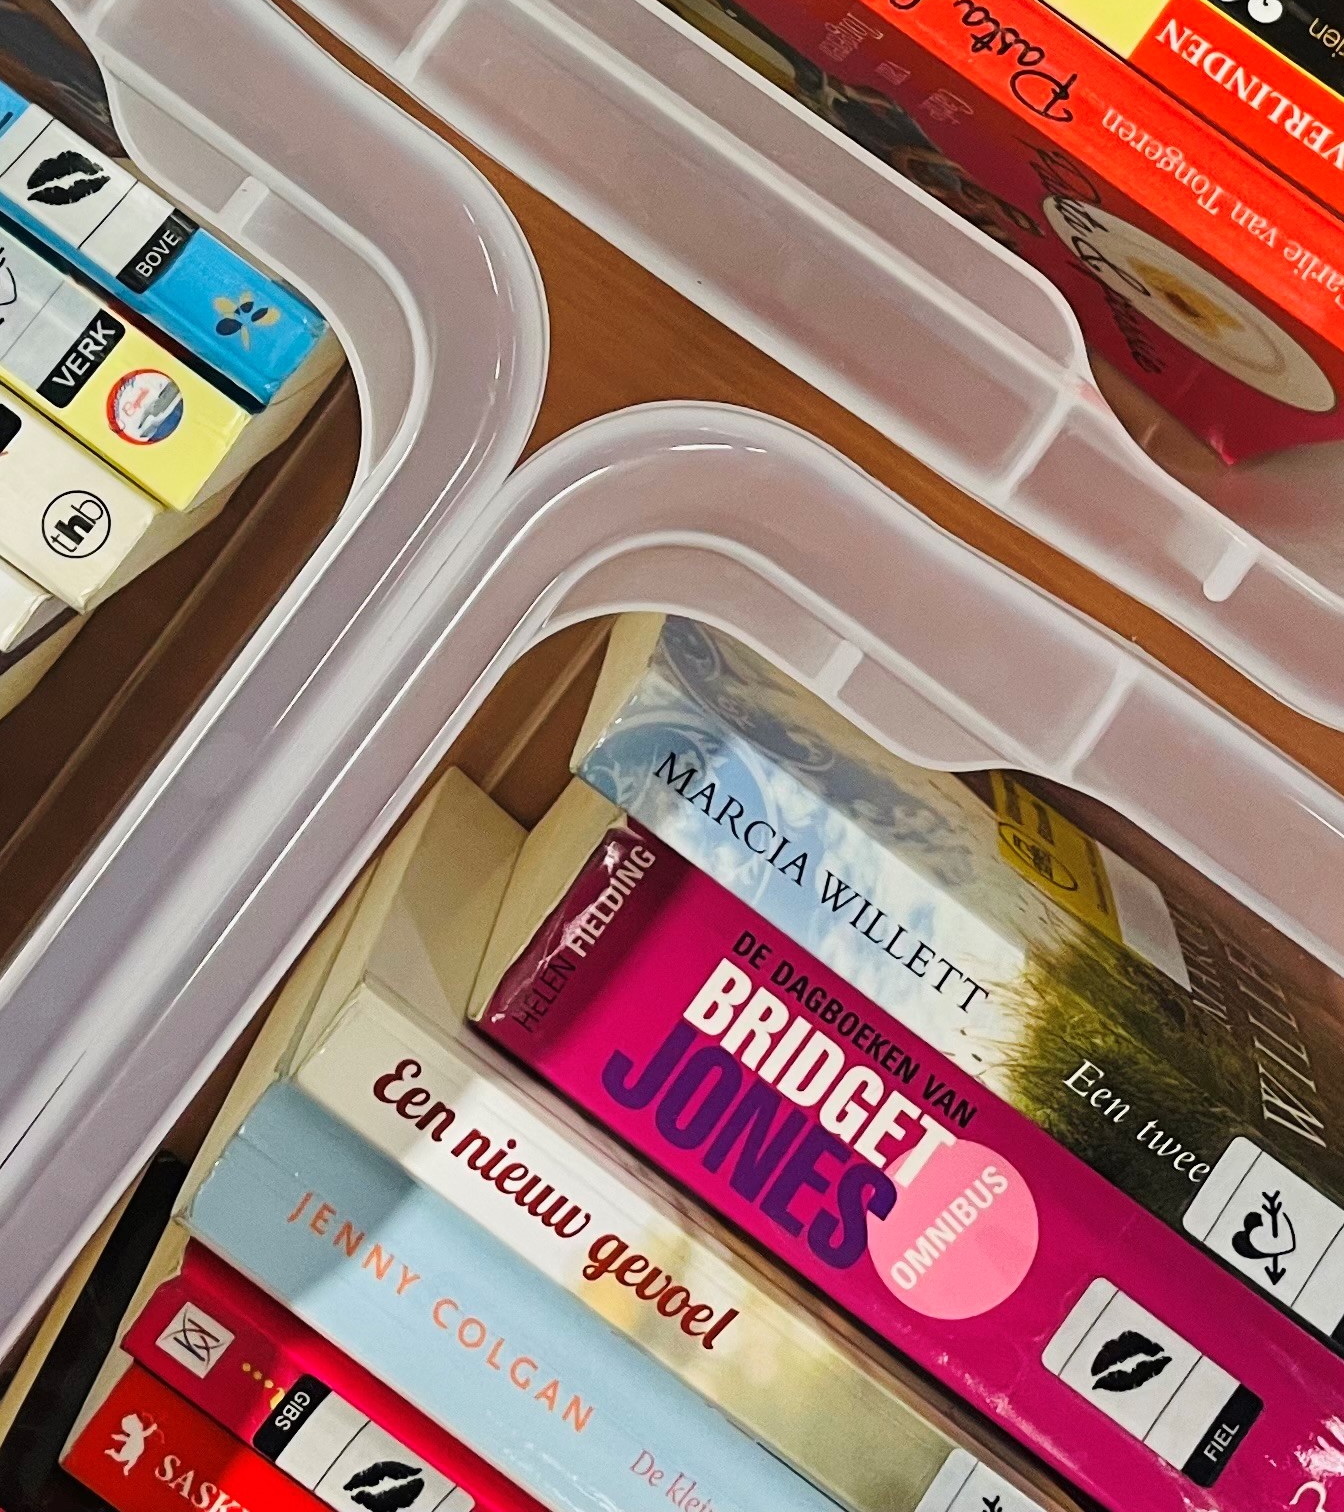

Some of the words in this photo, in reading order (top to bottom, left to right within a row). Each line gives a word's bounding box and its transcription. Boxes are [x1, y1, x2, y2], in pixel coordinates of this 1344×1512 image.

[1092, 101, 1234, 216] Tongeren
[1227, 198, 1284, 247] van
[131, 223, 184, 284] BOVE
[49, 316, 118, 397] VERK
[510, 953, 577, 1033] HELEN
[563, 842, 659, 961] FIELDING
[647, 749, 822, 889] MARCIA
[806, 869, 995, 1020] WILLETT
[674, 956, 965, 1196] BRIDGET
[730, 930, 774, 971] DE
[765, 959, 926, 1087] DAGBOEKEN
[915, 1072, 982, 1132] VAN
[1060, 1054, 1142, 1128] Een
[366, 1047, 472, 1145] Een
[446, 1113, 603, 1247] nieuw
[572, 1219, 741, 1364] gevoel
[585, 998, 912, 1277] JONES
[884, 1150, 1014, 1306] OMNIBUS
[284, 1187, 427, 1306] JENNY
[422, 1293, 602, 1436] COLGAN
[626, 1447, 670, 1490] De
[1200, 1416, 1242, 1465] FIEL
